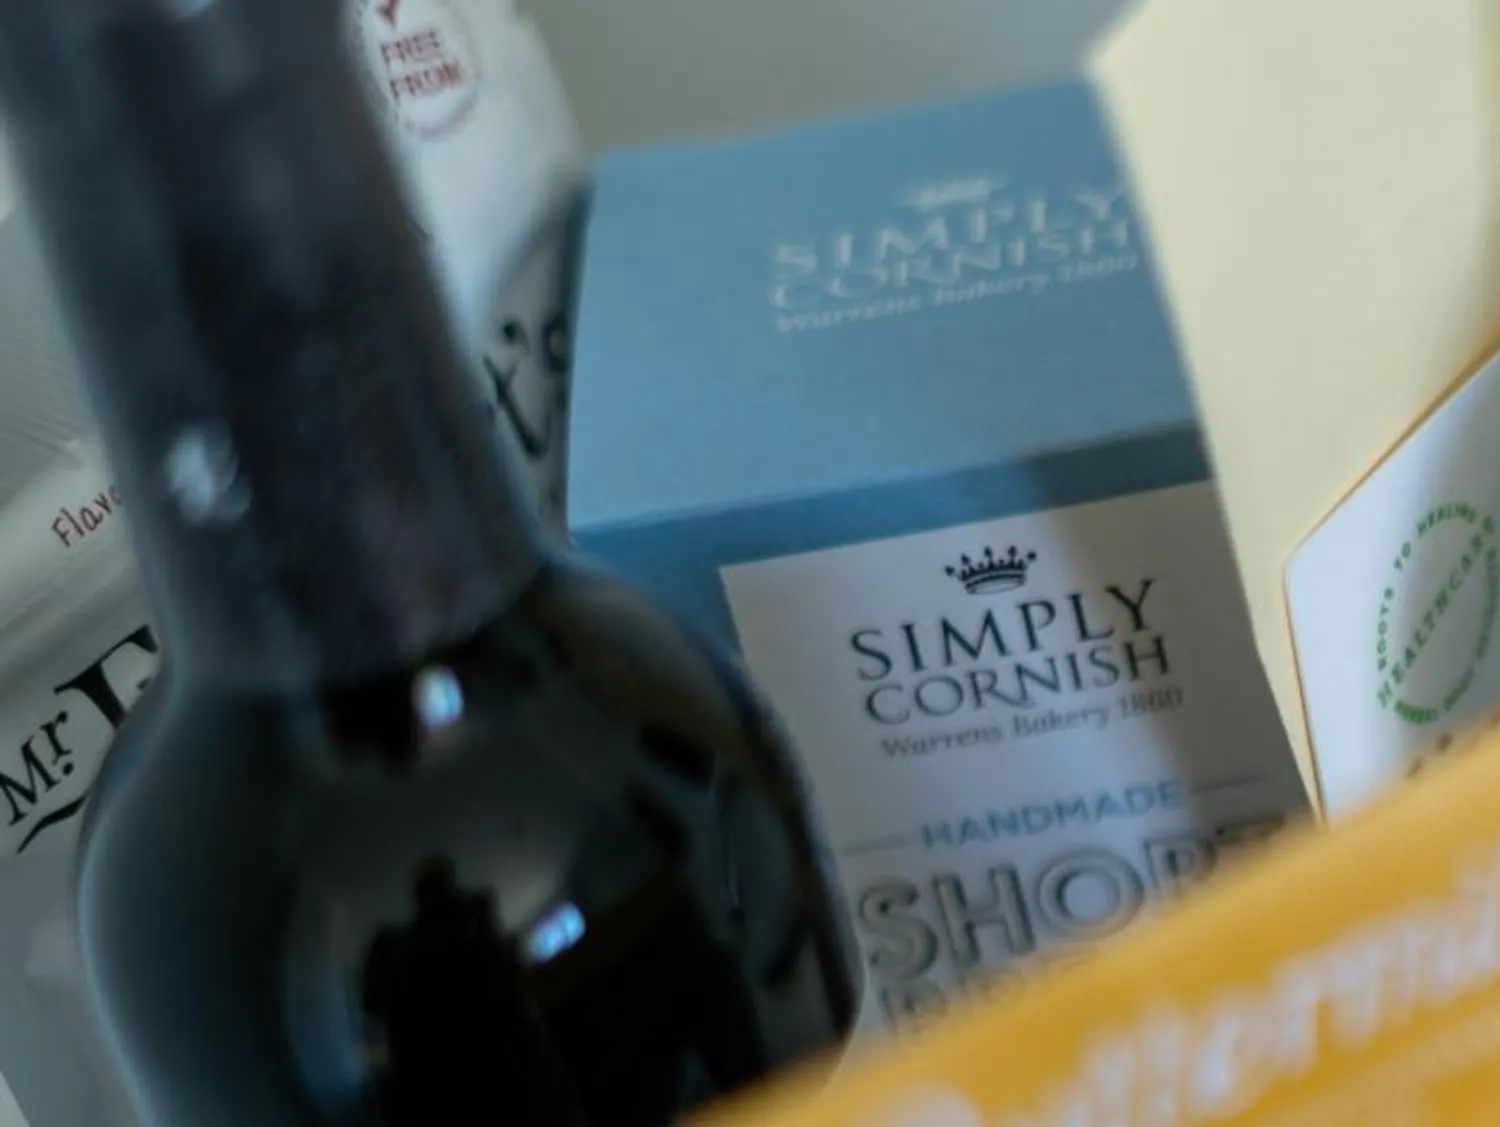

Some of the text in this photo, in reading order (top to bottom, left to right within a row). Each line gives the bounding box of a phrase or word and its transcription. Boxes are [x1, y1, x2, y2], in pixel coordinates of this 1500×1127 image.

[380, 30, 440, 65] FREE
[390, 56, 465, 98] FROM
[850, 578, 1157, 681] SIMPLY
[865, 635, 1171, 726] CORNISH
[880, 724, 1002, 760] Warrens
[1012, 705, 1111, 746] Bakery
[921, 779, 1182, 848] HANDMADE
